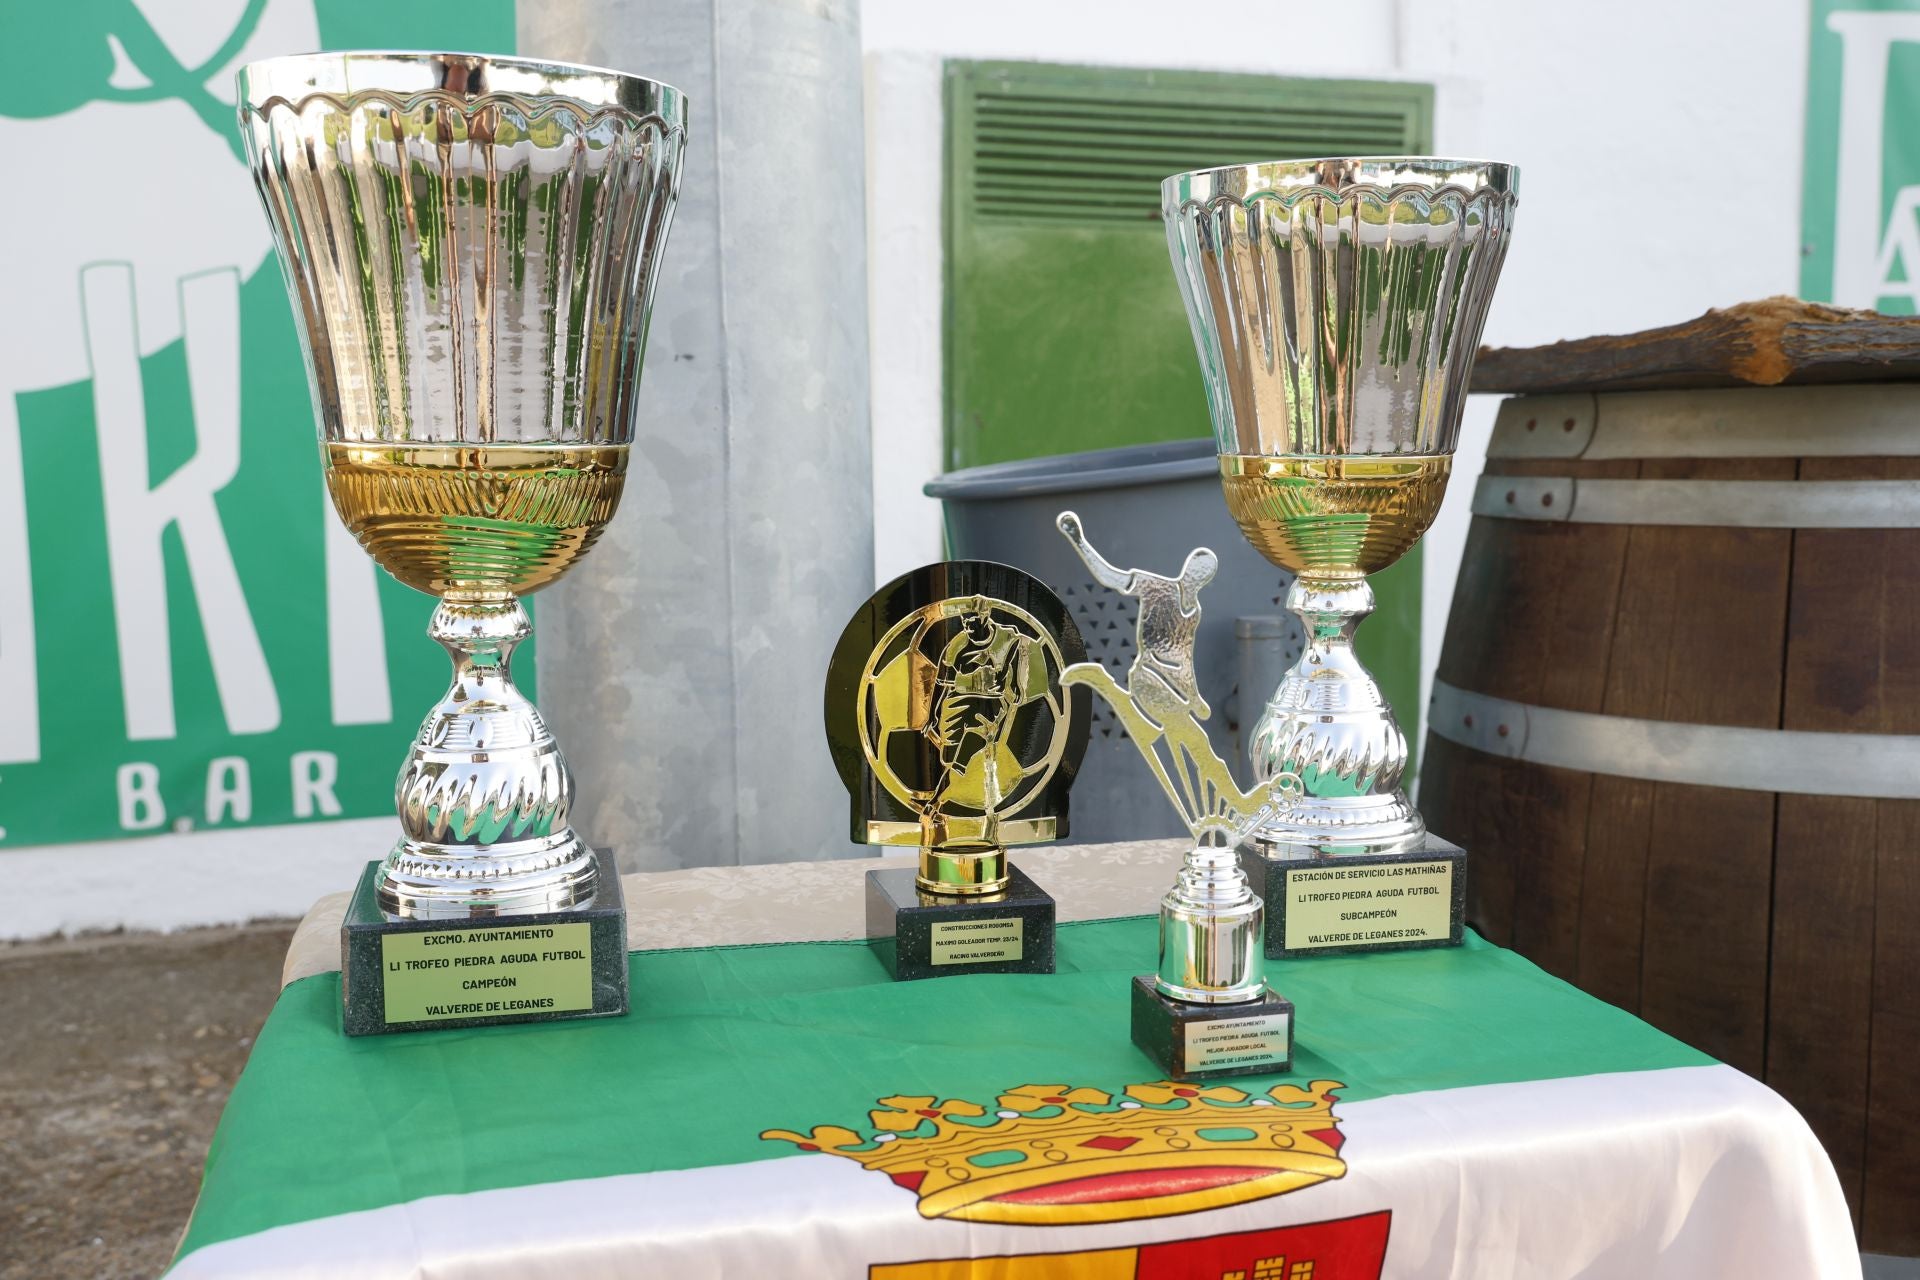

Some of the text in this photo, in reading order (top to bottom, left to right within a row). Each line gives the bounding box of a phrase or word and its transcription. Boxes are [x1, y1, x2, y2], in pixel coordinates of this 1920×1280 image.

[117, 752, 342, 831] BAR
[1292, 865, 1447, 882] ESTACIÓN DE SERVICIO LAS MATHIÑAS
[1298, 886, 1439, 903] LI TROFEO PIEDRA AGUDA FUTBOL
[1340, 909, 1397, 921] SUBCAMPEÓN
[941, 924, 988, 932] CONSTRUCCIONES
[1308, 928, 1428, 943] VALVERDE DE LEGANES 2024.
[424, 928, 554, 946] EXCMO. AYUNTAMIENTO
[390, 950, 586, 971] LI TROFEO PIEDRA AGUDA FUTBOL
[462, 976, 516, 990] CAMPEÓN
[426, 998, 554, 1015] VALVERDE DE LEGANES
[1226, 1020, 1265, 1028] AYUNTAMIENTO
[1225, 1044, 1249, 1052] JUGADOR
[1200, 1058, 1226, 1066] VALVERDE
